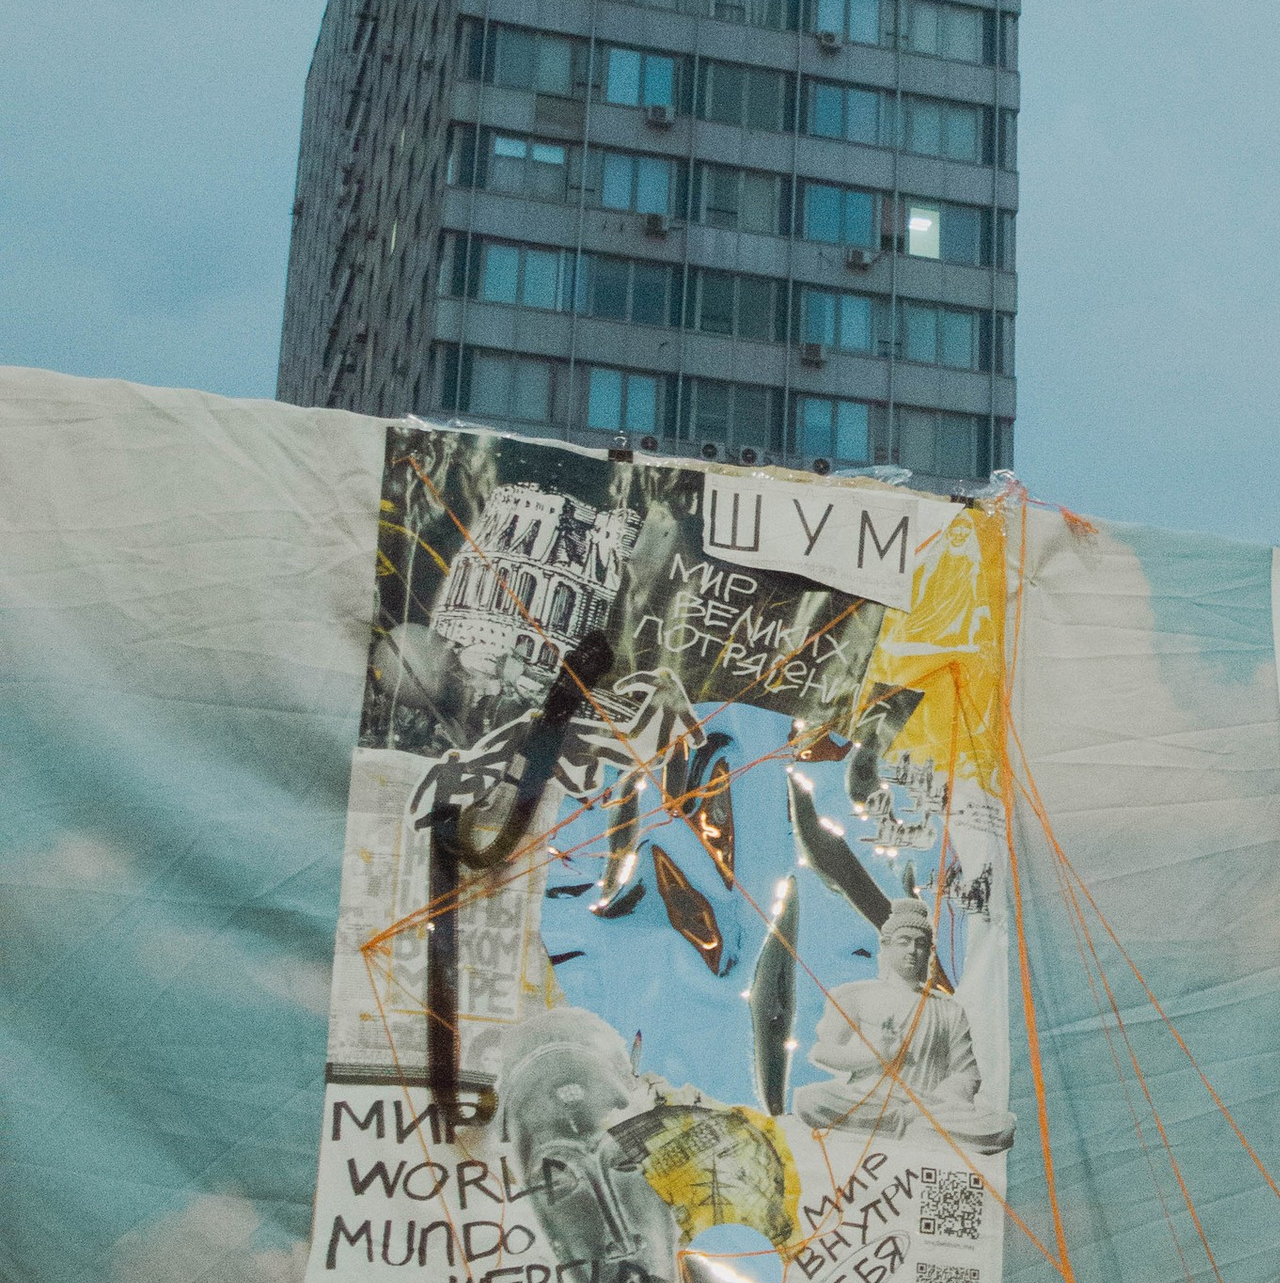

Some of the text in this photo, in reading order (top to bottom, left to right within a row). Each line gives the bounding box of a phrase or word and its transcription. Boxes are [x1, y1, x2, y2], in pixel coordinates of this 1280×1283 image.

[709, 488, 910, 574] ШУМ
[669, 553, 758, 602] МИР
[676, 590, 850, 664] ВЕЛИКИХ
[347, 1156, 573, 1209] WORLD
[803, 1152, 888, 1230] МИР
[794, 1169, 919, 1280] ВНУТРИ
